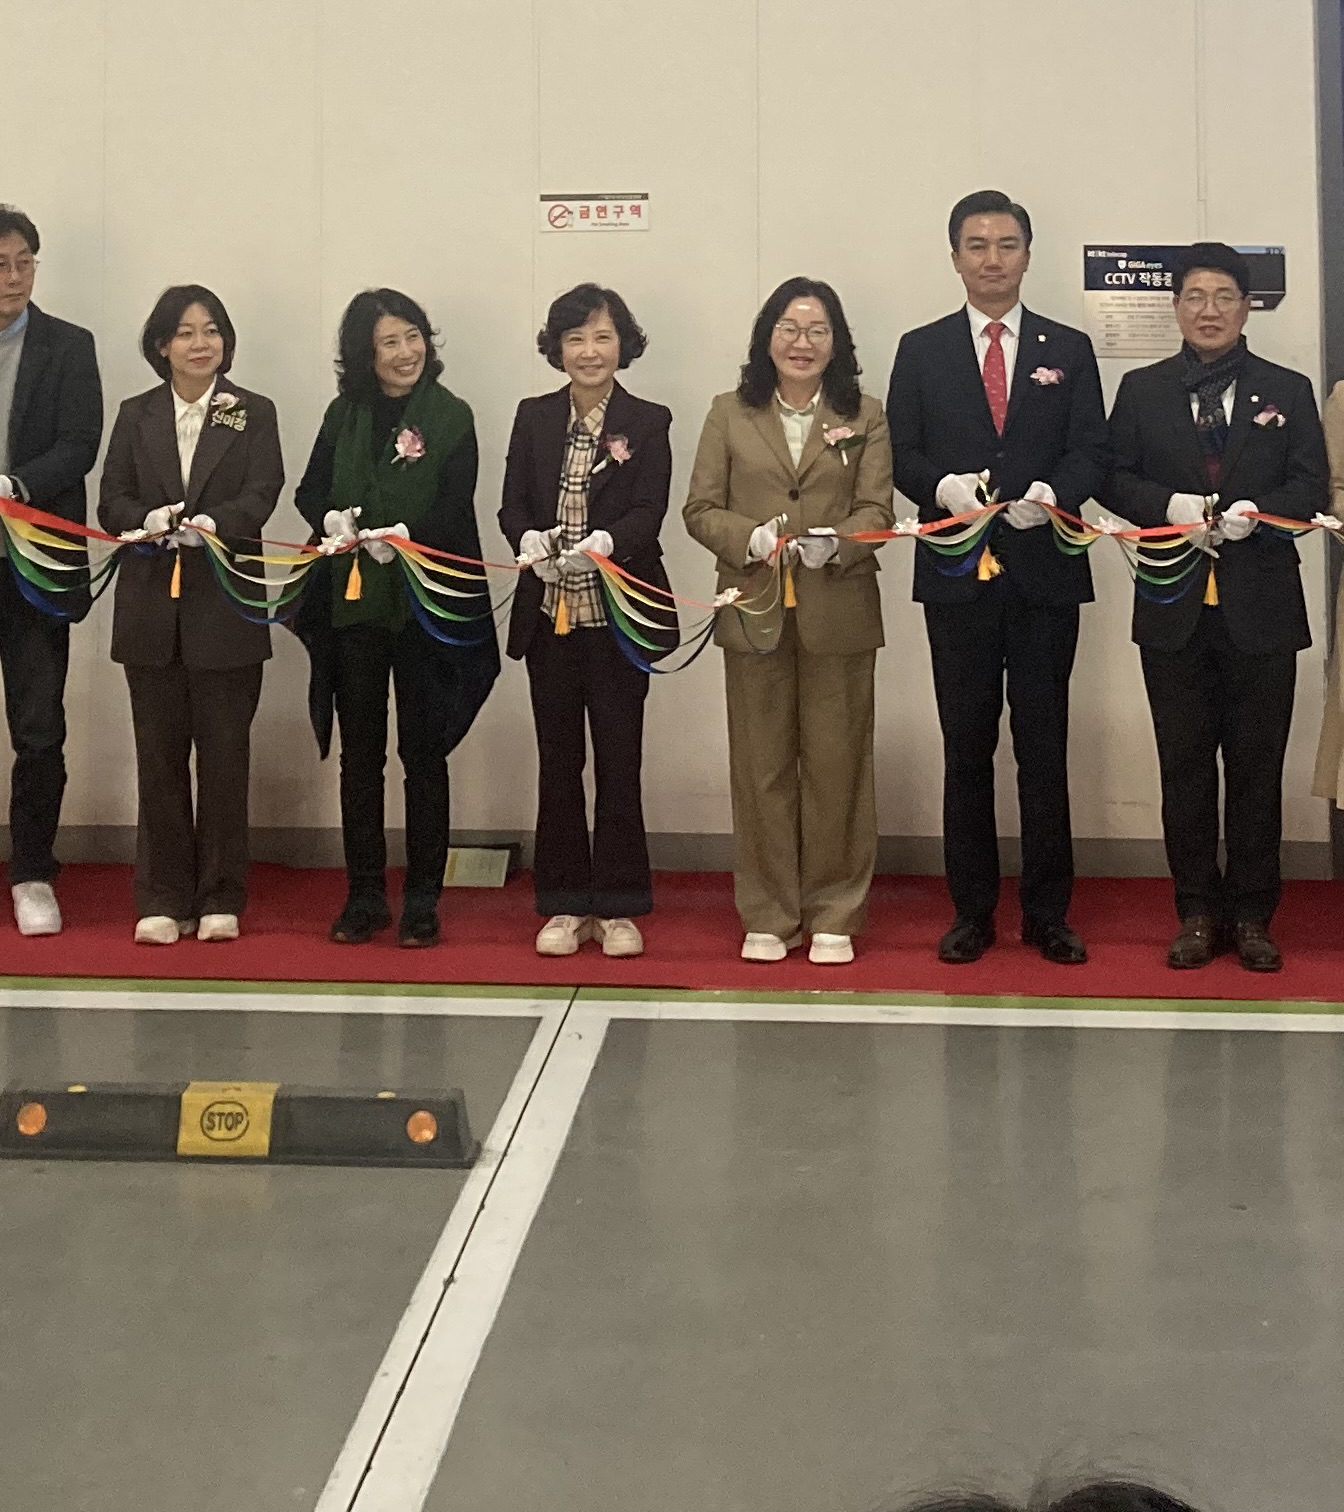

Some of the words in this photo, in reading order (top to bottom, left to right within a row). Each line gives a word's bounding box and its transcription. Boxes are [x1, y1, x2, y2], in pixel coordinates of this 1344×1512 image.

[579, 205, 642, 219] 금연구역
[1104, 272, 1136, 285] CCTV
[206, 1111, 244, 1132] STOP
